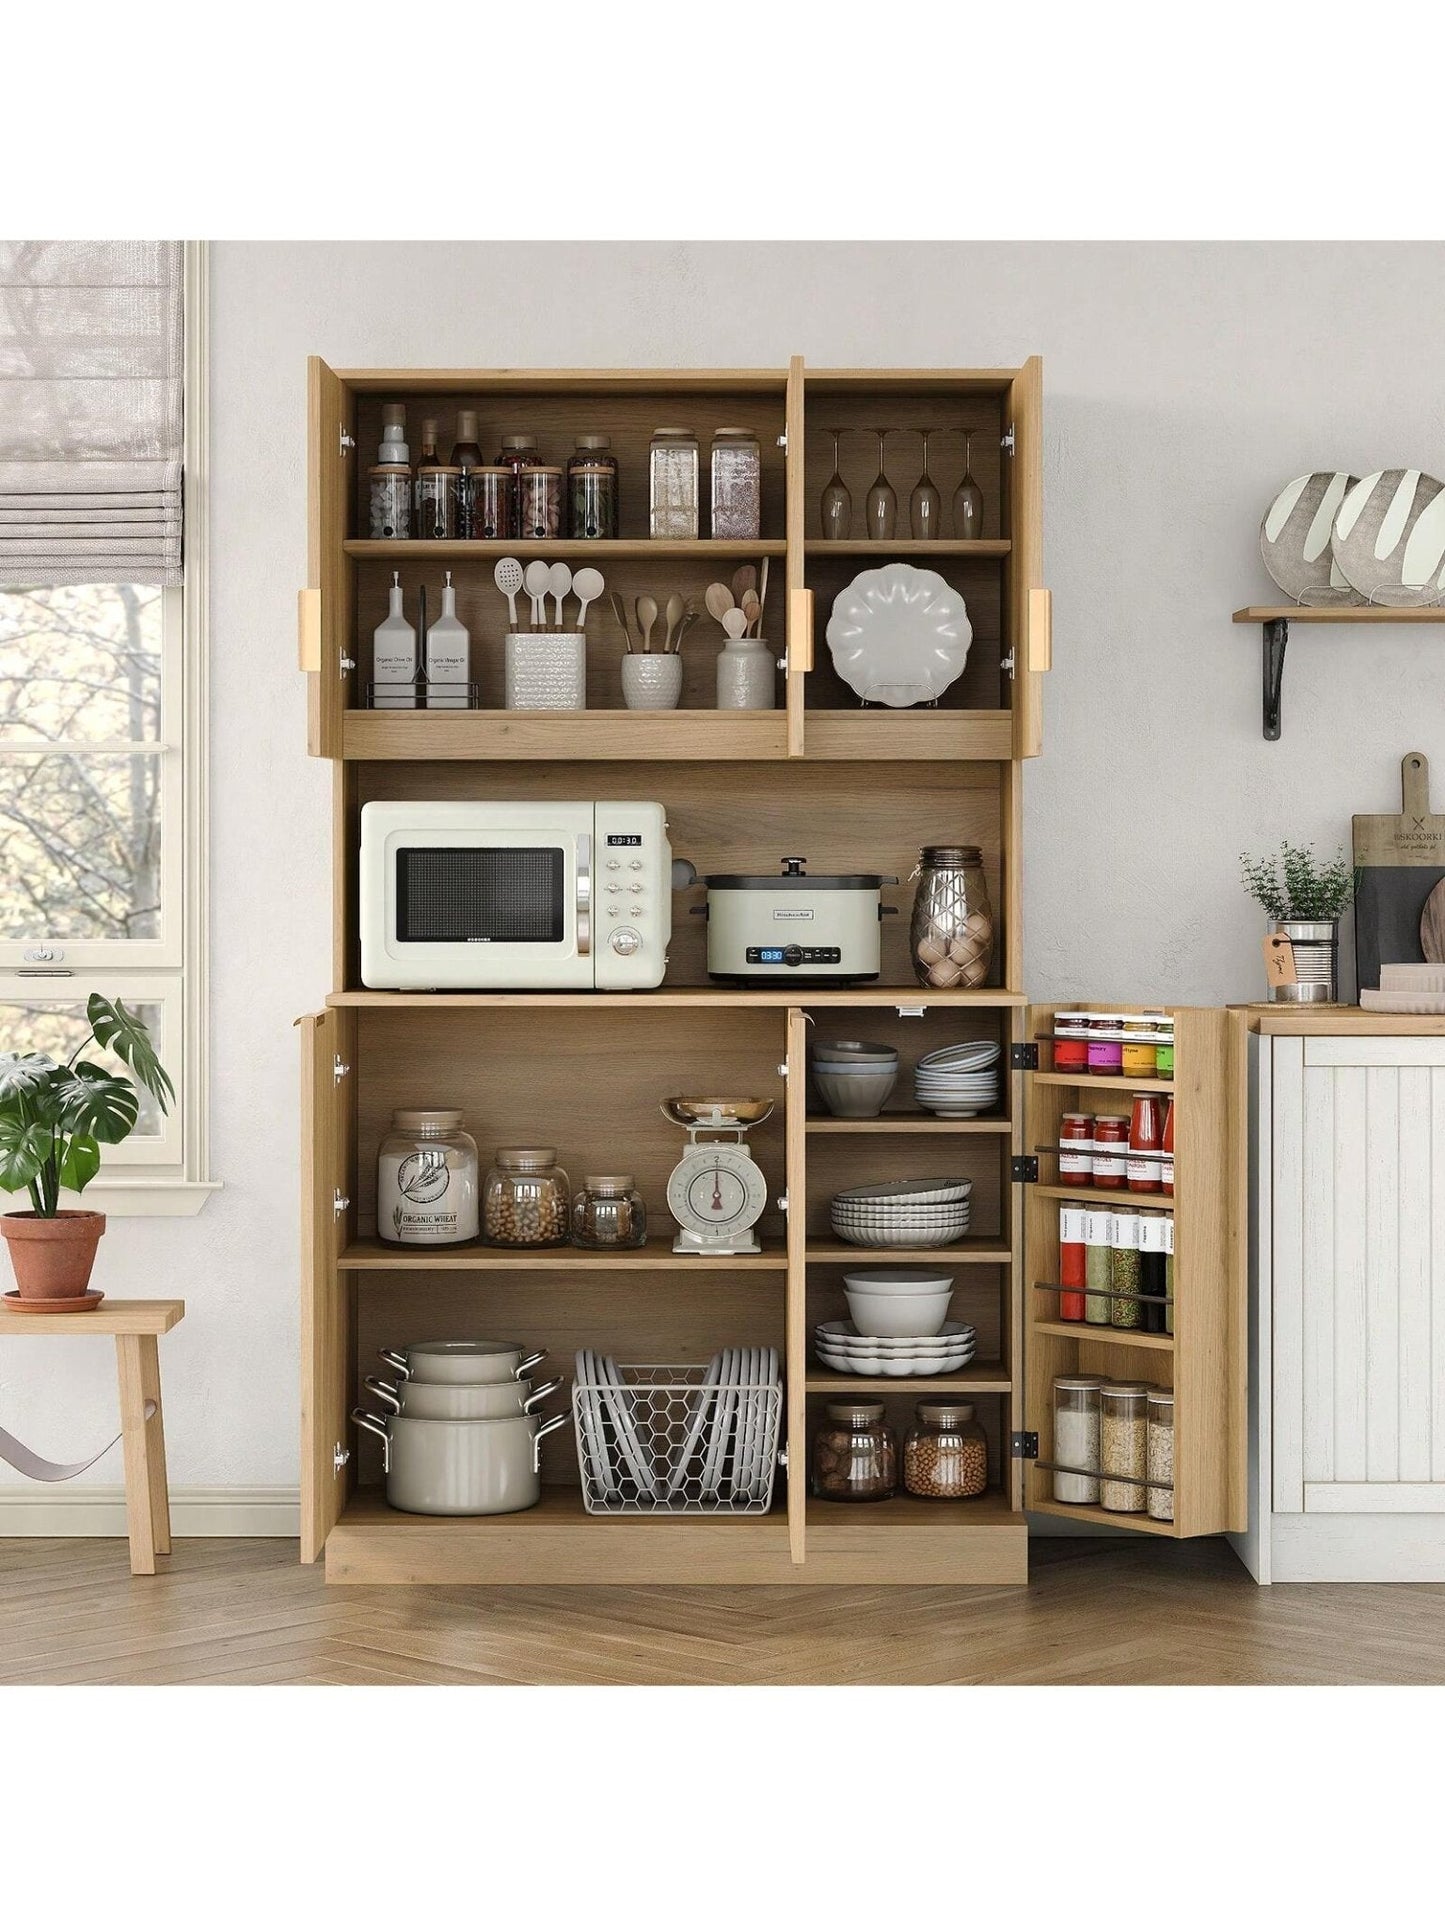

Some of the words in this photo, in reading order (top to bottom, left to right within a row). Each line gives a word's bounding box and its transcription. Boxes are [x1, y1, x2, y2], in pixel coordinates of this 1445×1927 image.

[761, 951, 782, 960] 03:30
[1272, 955, 1285, 975] Thyme
[402, 1215, 433, 1224] ORGANIC
[434, 1214, 458, 1223] WHEAT
